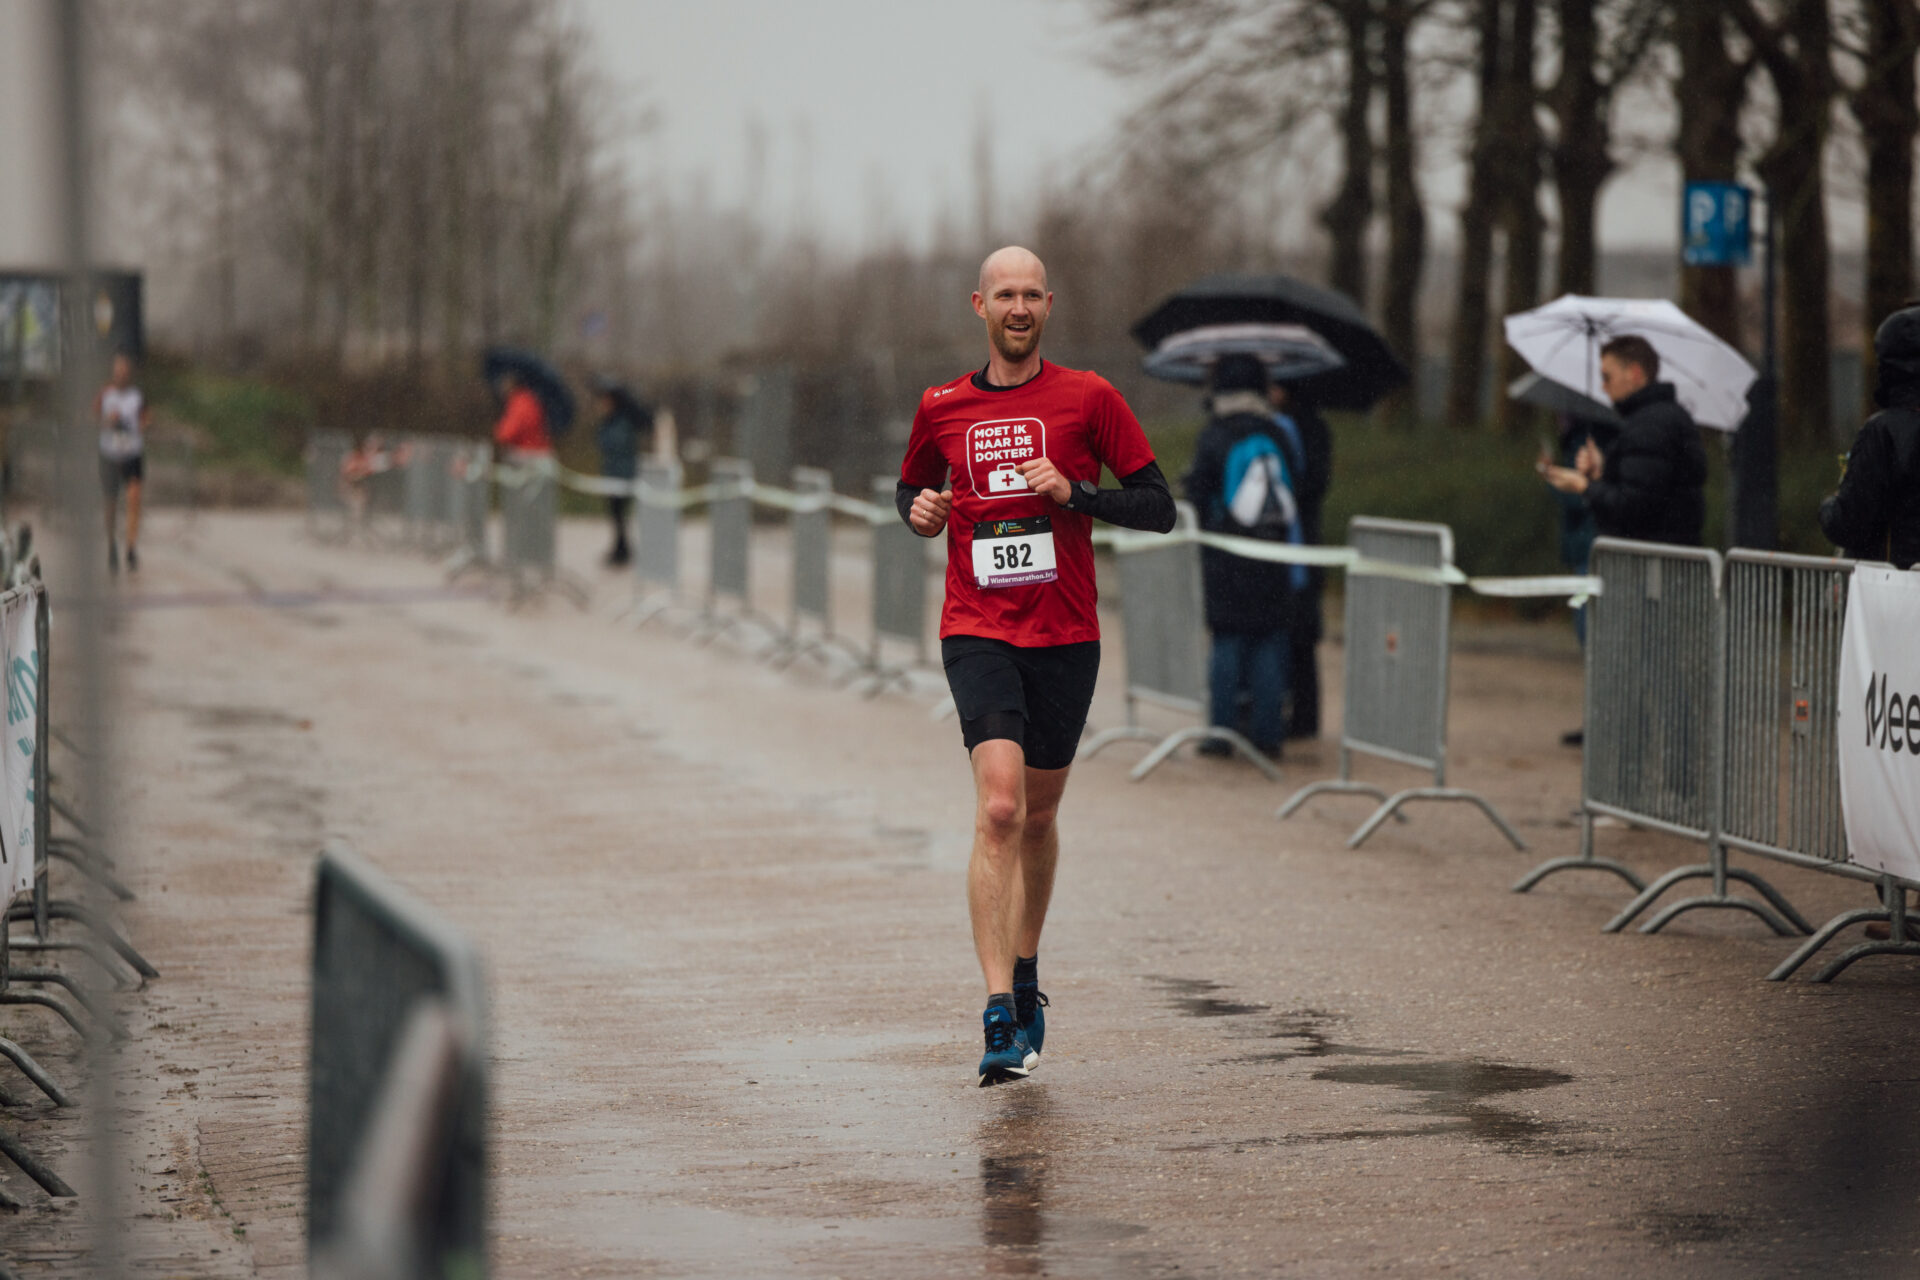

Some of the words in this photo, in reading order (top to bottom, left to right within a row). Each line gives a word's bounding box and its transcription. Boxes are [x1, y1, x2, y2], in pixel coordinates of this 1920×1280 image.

[1689, 188, 1717, 236] P
[975, 426, 1010, 439] MOET
[1013, 424, 1027, 435] IK
[975, 437, 1011, 451] NAAR
[1014, 435, 1032, 446] DE
[975, 447, 1034, 463] DOKTER?
[993, 543, 1033, 570] 582
